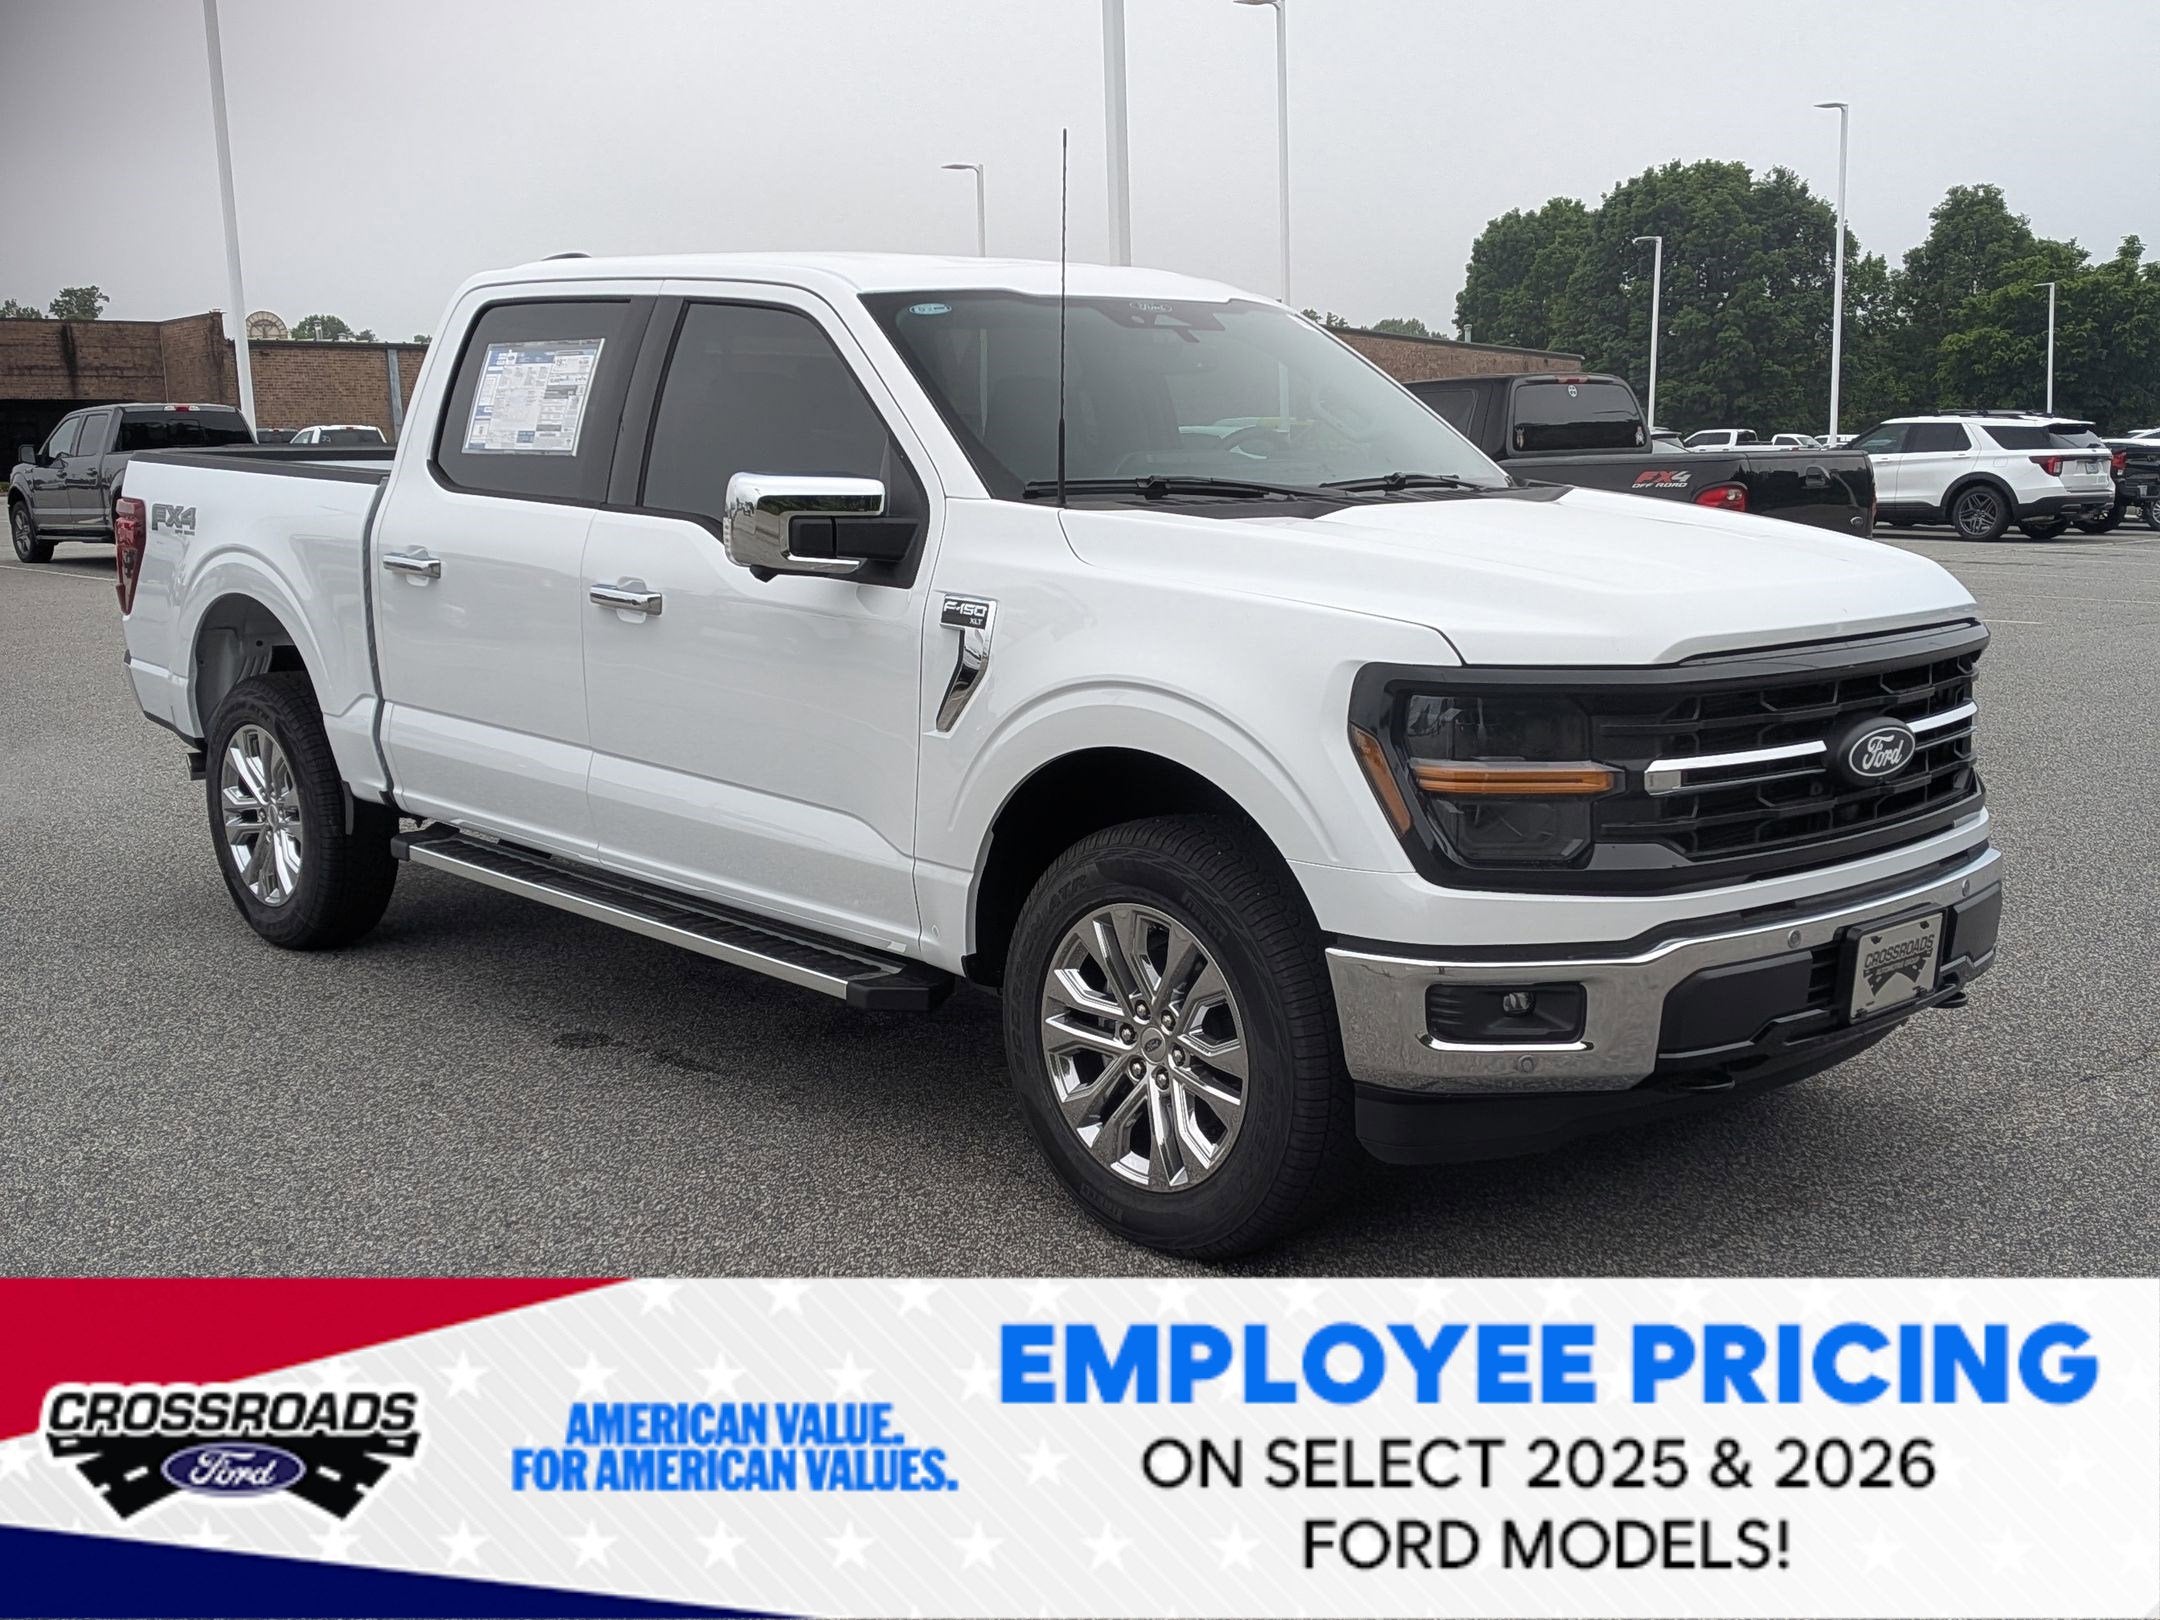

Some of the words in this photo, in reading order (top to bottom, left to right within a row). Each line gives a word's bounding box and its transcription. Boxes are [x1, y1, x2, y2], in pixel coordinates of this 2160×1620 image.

[1634, 470, 1692, 483] FX4
[151, 503, 197, 531] FX4
[943, 600, 988, 618] F-150
[969, 617, 984, 625] XLT
[1862, 734, 1904, 770] Ford
[1864, 934, 1935, 968] CROSSROADS
